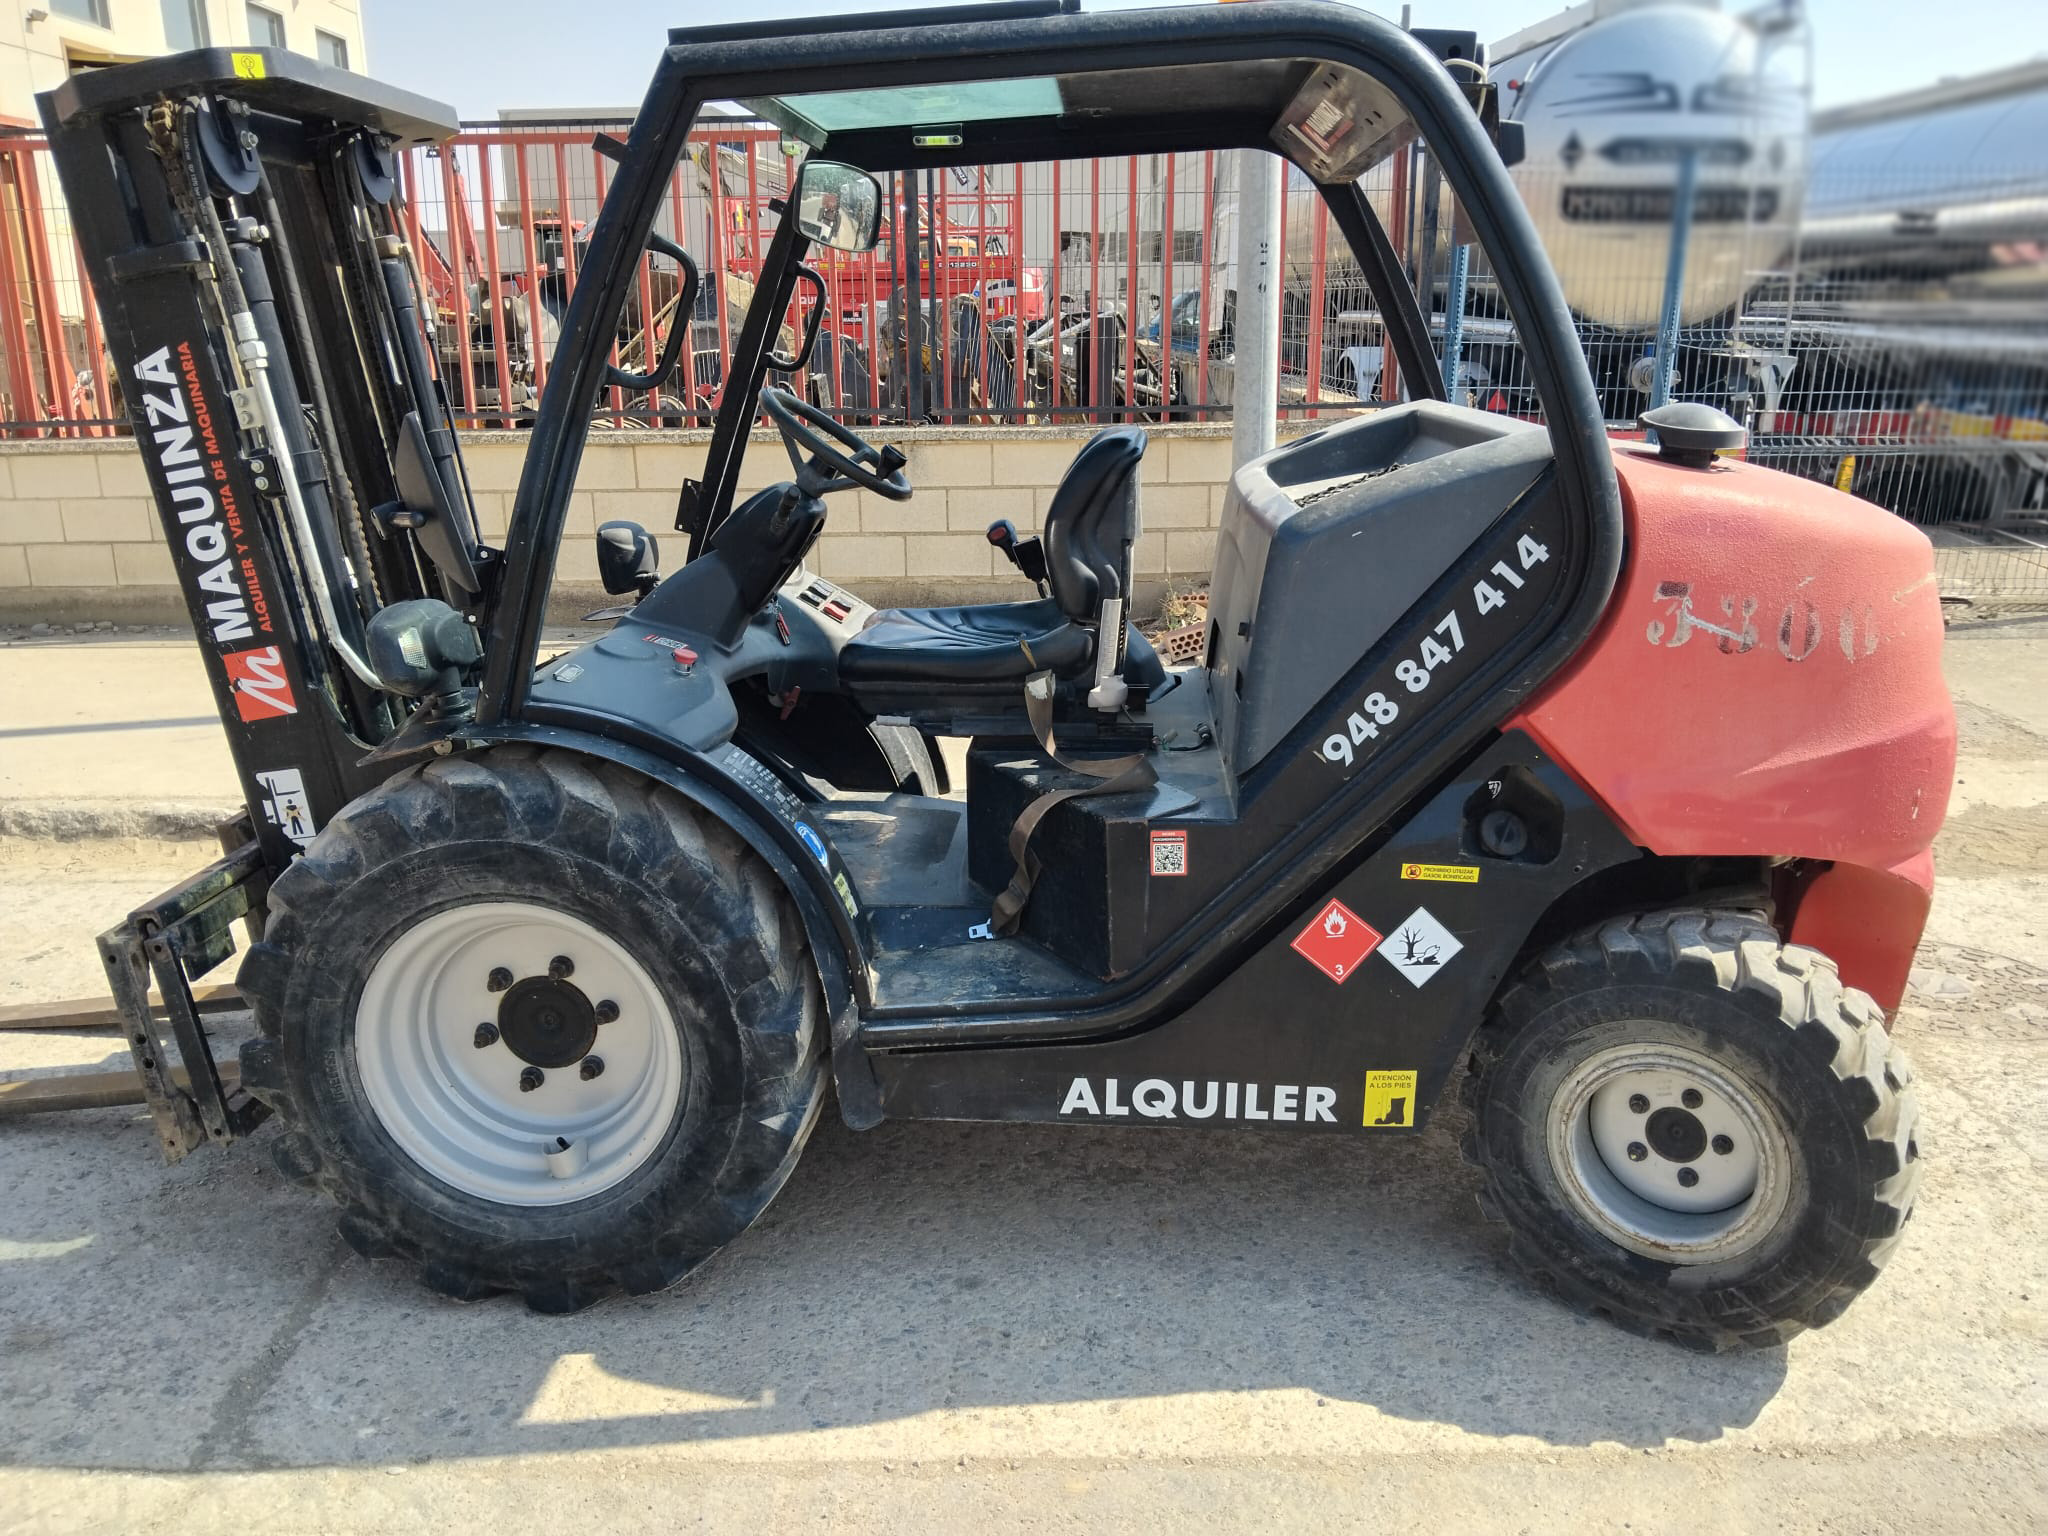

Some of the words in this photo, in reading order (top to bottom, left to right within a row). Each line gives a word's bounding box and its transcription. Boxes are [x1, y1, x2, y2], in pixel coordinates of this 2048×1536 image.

[177, 341, 220, 455] MAQUINARIA
[133, 345, 255, 642] MAQUINZA
[211, 459, 227, 480] DE
[219, 484, 244, 541] VENTA
[235, 544, 249, 555] Y
[241, 558, 273, 632] ALQUILER
[1322, 692, 1399, 767] 948
[1395, 609, 1465, 693] 847
[1473, 534, 1550, 616] 414
[1335, 964, 1344, 976] 3
[1059, 1077, 1338, 1123] ALQUILER
